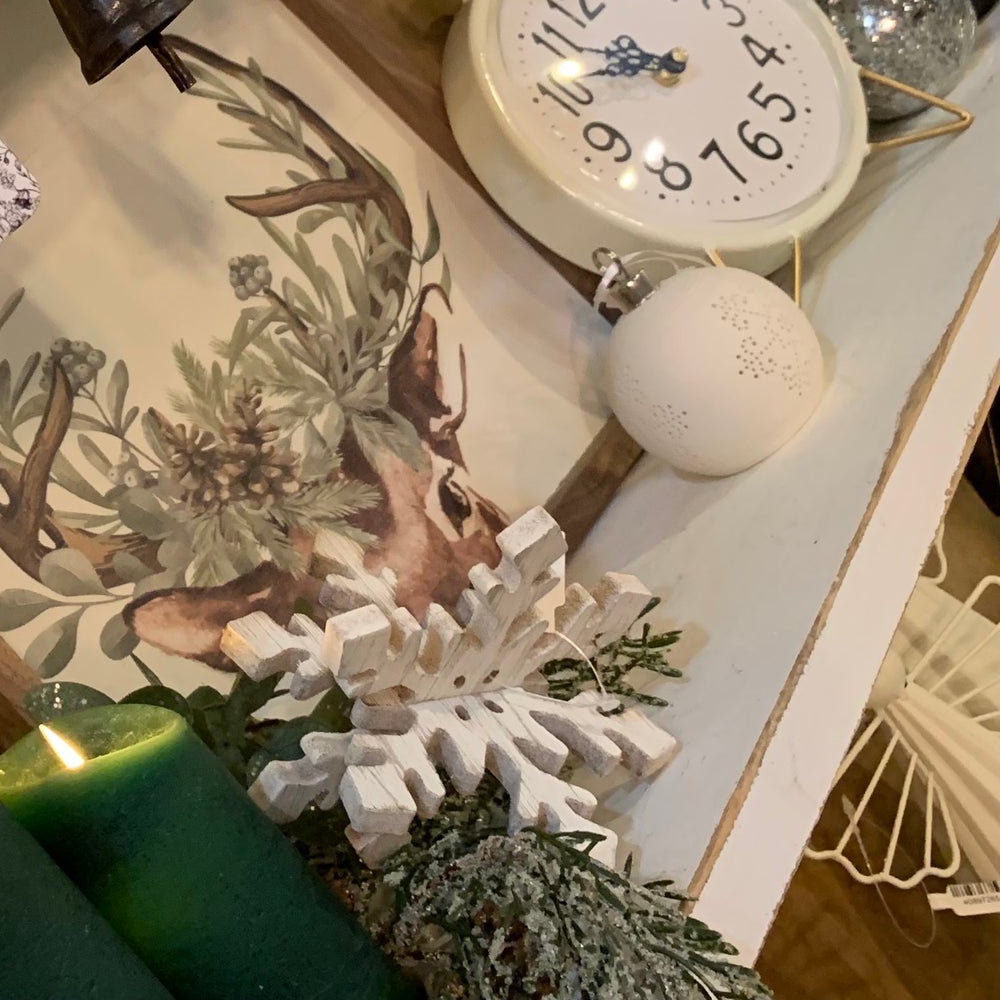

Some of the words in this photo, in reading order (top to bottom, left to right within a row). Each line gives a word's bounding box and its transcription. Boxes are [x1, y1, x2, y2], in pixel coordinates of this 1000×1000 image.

[531, 21, 585, 60] 11
[741, 33, 786, 68] 4
[536, 72, 595, 118] 10
[747, 81, 797, 123] 5
[582, 121, 633, 163] 9
[698, 138, 748, 184] 7
[737, 119, 784, 162] 6
[643, 146, 693, 191] 8
